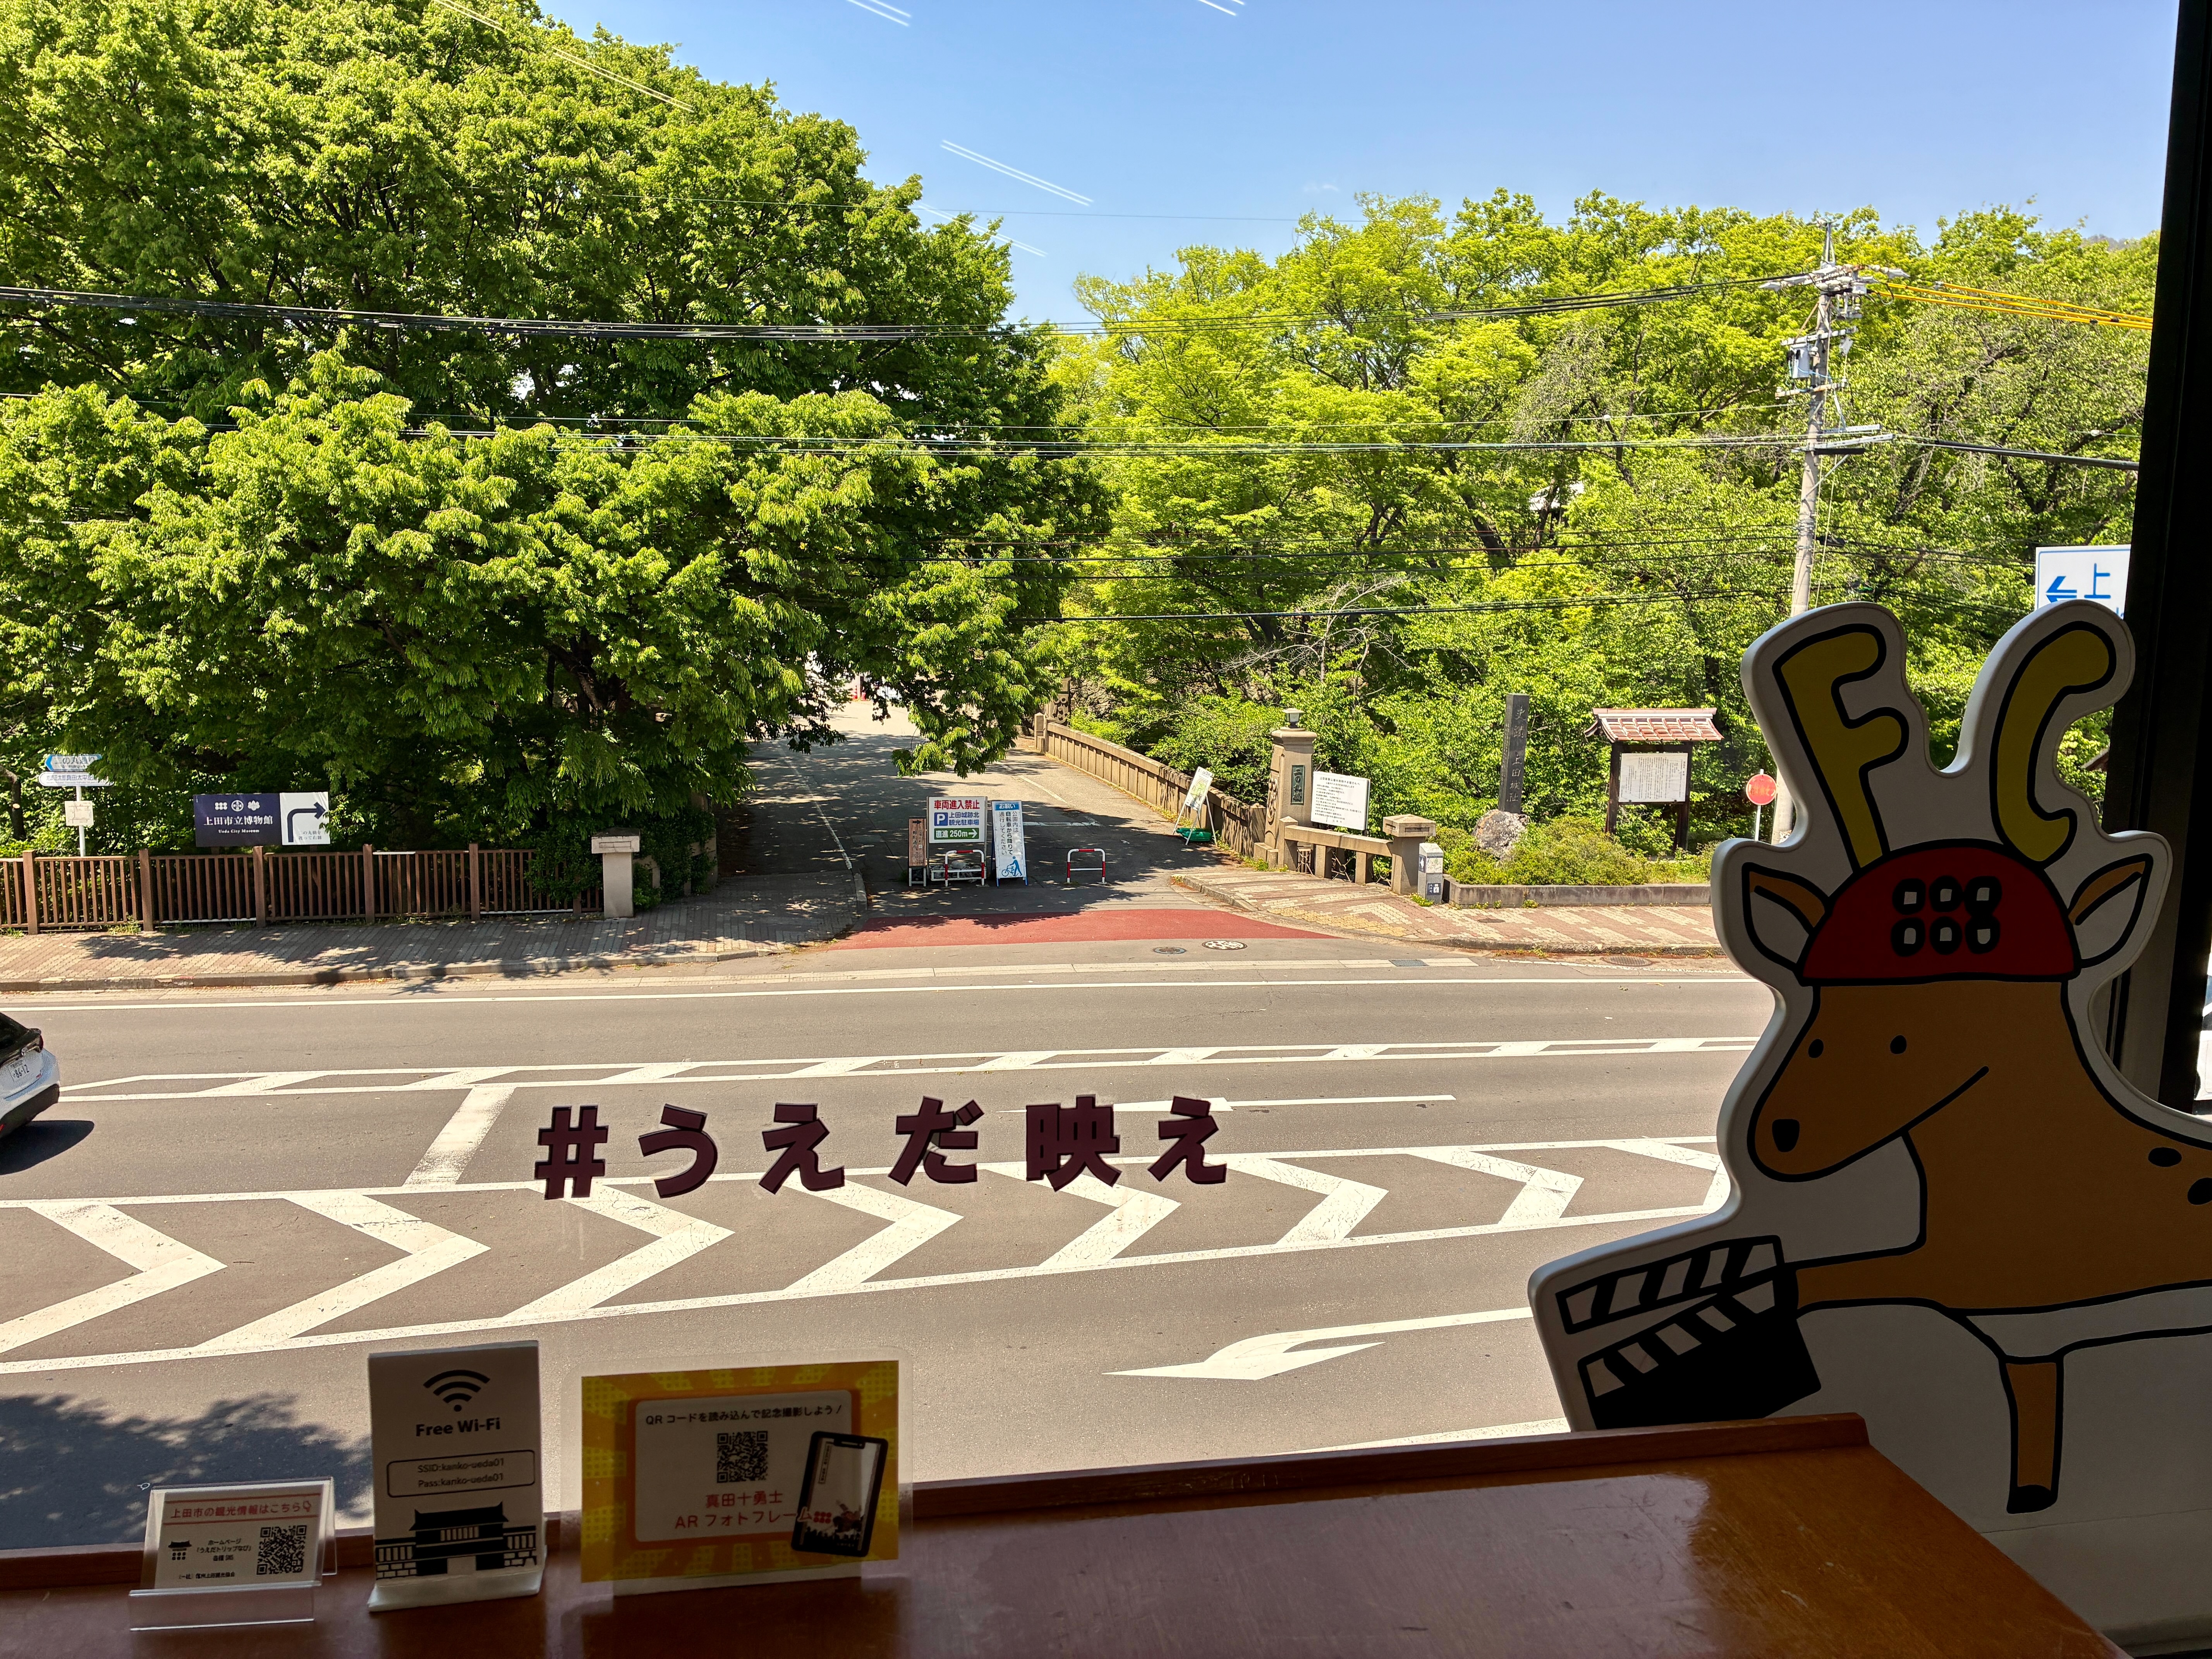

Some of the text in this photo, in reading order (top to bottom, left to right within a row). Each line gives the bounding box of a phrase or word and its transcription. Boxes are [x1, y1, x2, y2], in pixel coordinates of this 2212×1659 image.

[934, 800, 980, 810] 車両進入禁止
[204, 815, 273, 825] 上田市立博物館
[936, 830, 948, 838] 直進
[999, 811, 1007, 855] 通行してください
[534, 1094, 1228, 1200] #うえだ映え
[415, 1417, 500, 1437] Free Wi-Fi
[705, 1489, 783, 1508] 真田十勇士
[170, 1503, 302, 1519] 上田市の観光情報はこちら
